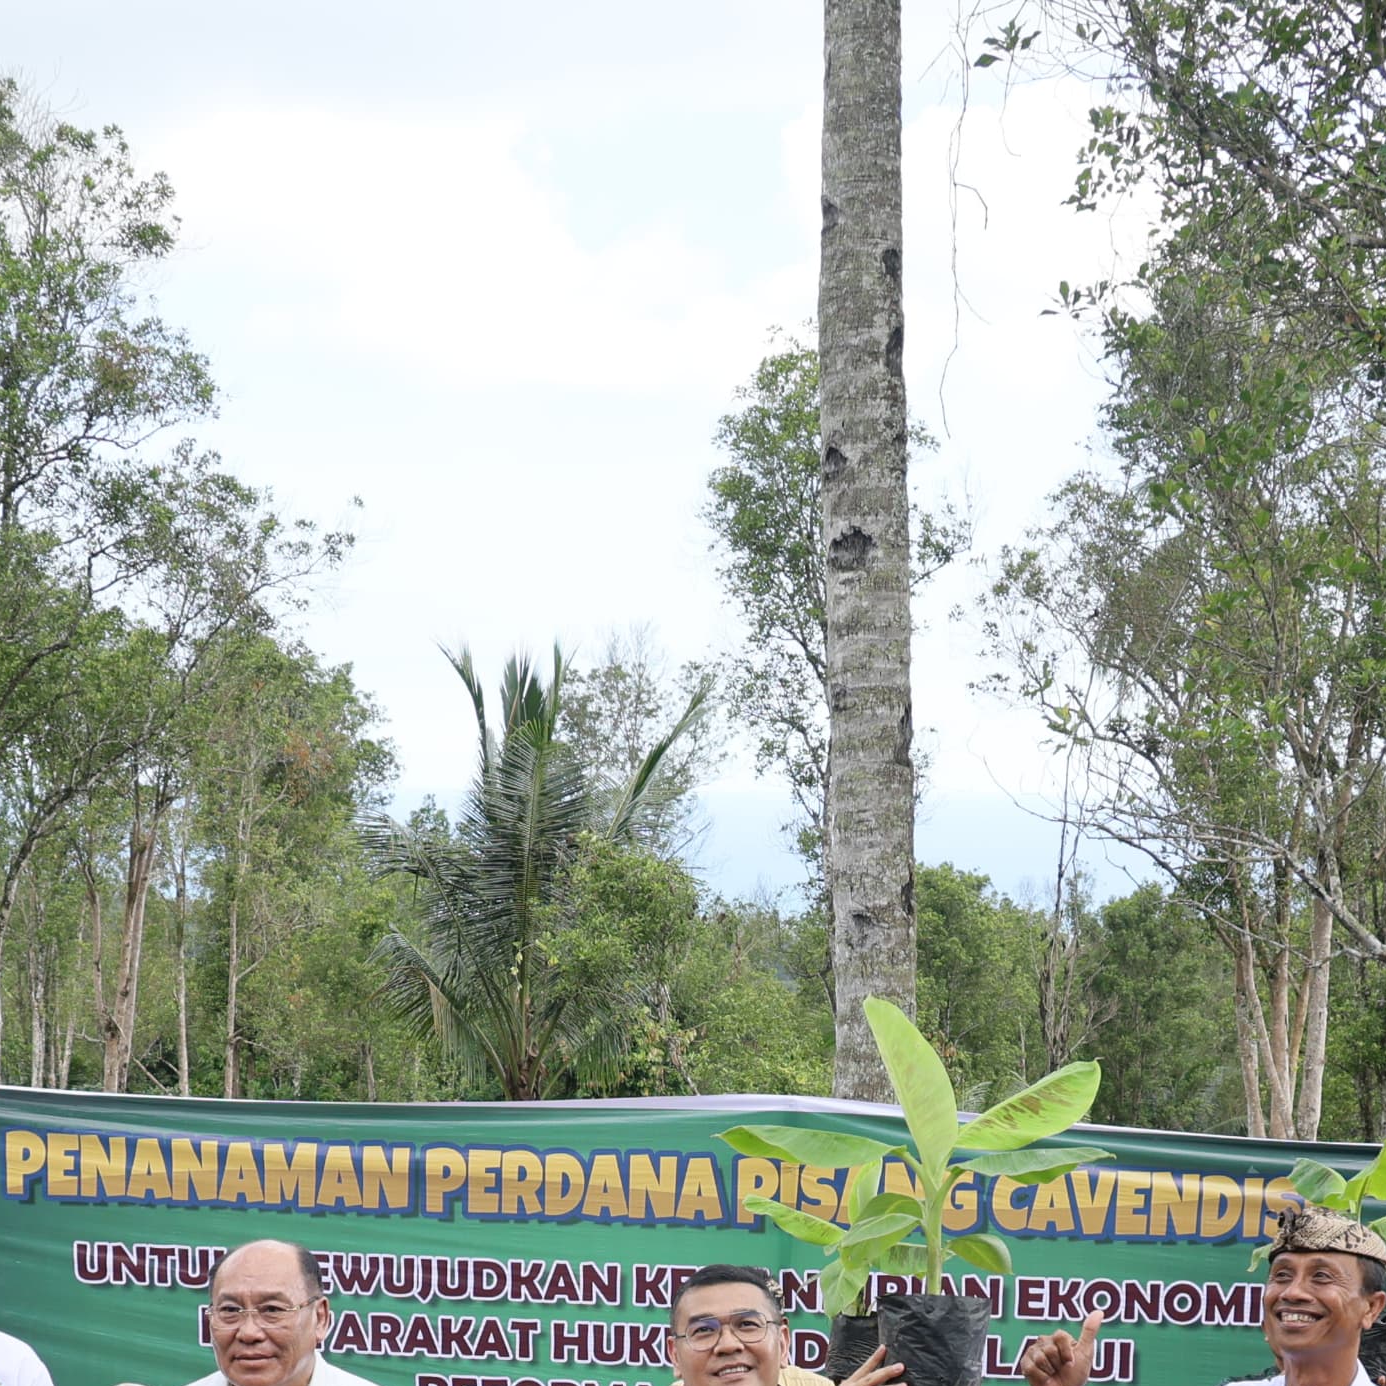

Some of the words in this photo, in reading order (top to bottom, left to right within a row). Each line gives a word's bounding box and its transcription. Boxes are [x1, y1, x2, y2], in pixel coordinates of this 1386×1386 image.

[3, 1128, 413, 1212] PENANAMAN
[422, 1144, 726, 1224] PERDANA
[990, 1169, 1308, 1241] CAVENDIS
[73, 1240, 227, 1290] UNTU
[310, 1251, 620, 1306] EWUJUDKAN
[1015, 1274, 1266, 1327] EKONOMI
